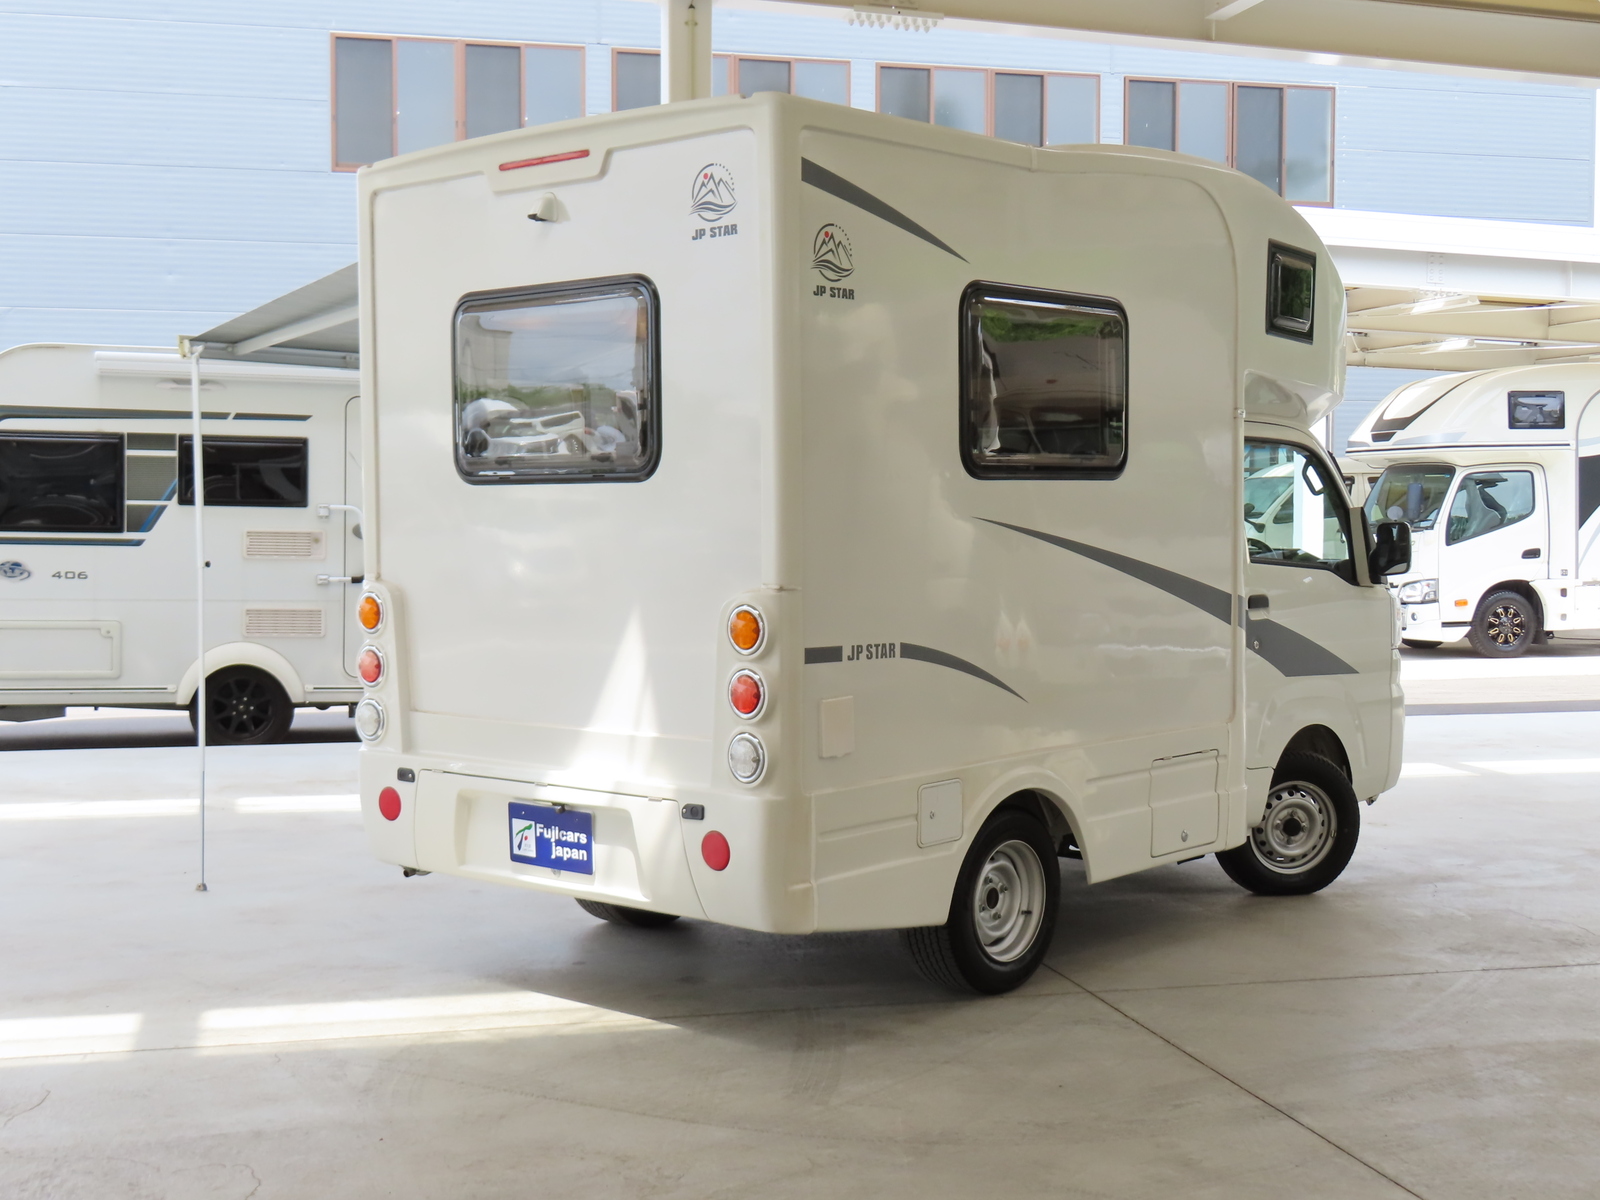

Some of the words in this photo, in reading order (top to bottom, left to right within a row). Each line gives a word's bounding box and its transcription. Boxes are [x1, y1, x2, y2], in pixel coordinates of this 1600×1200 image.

[691, 228, 706, 241] JP
[709, 223, 738, 239] STAR
[813, 285, 826, 297] JP
[829, 286, 855, 300] STAR
[51, 570, 88, 580] 406
[847, 644, 863, 661] JP
[866, 642, 896, 660] STAR
[535, 823, 588, 844] Fujicars
[550, 841, 588, 861] japan
